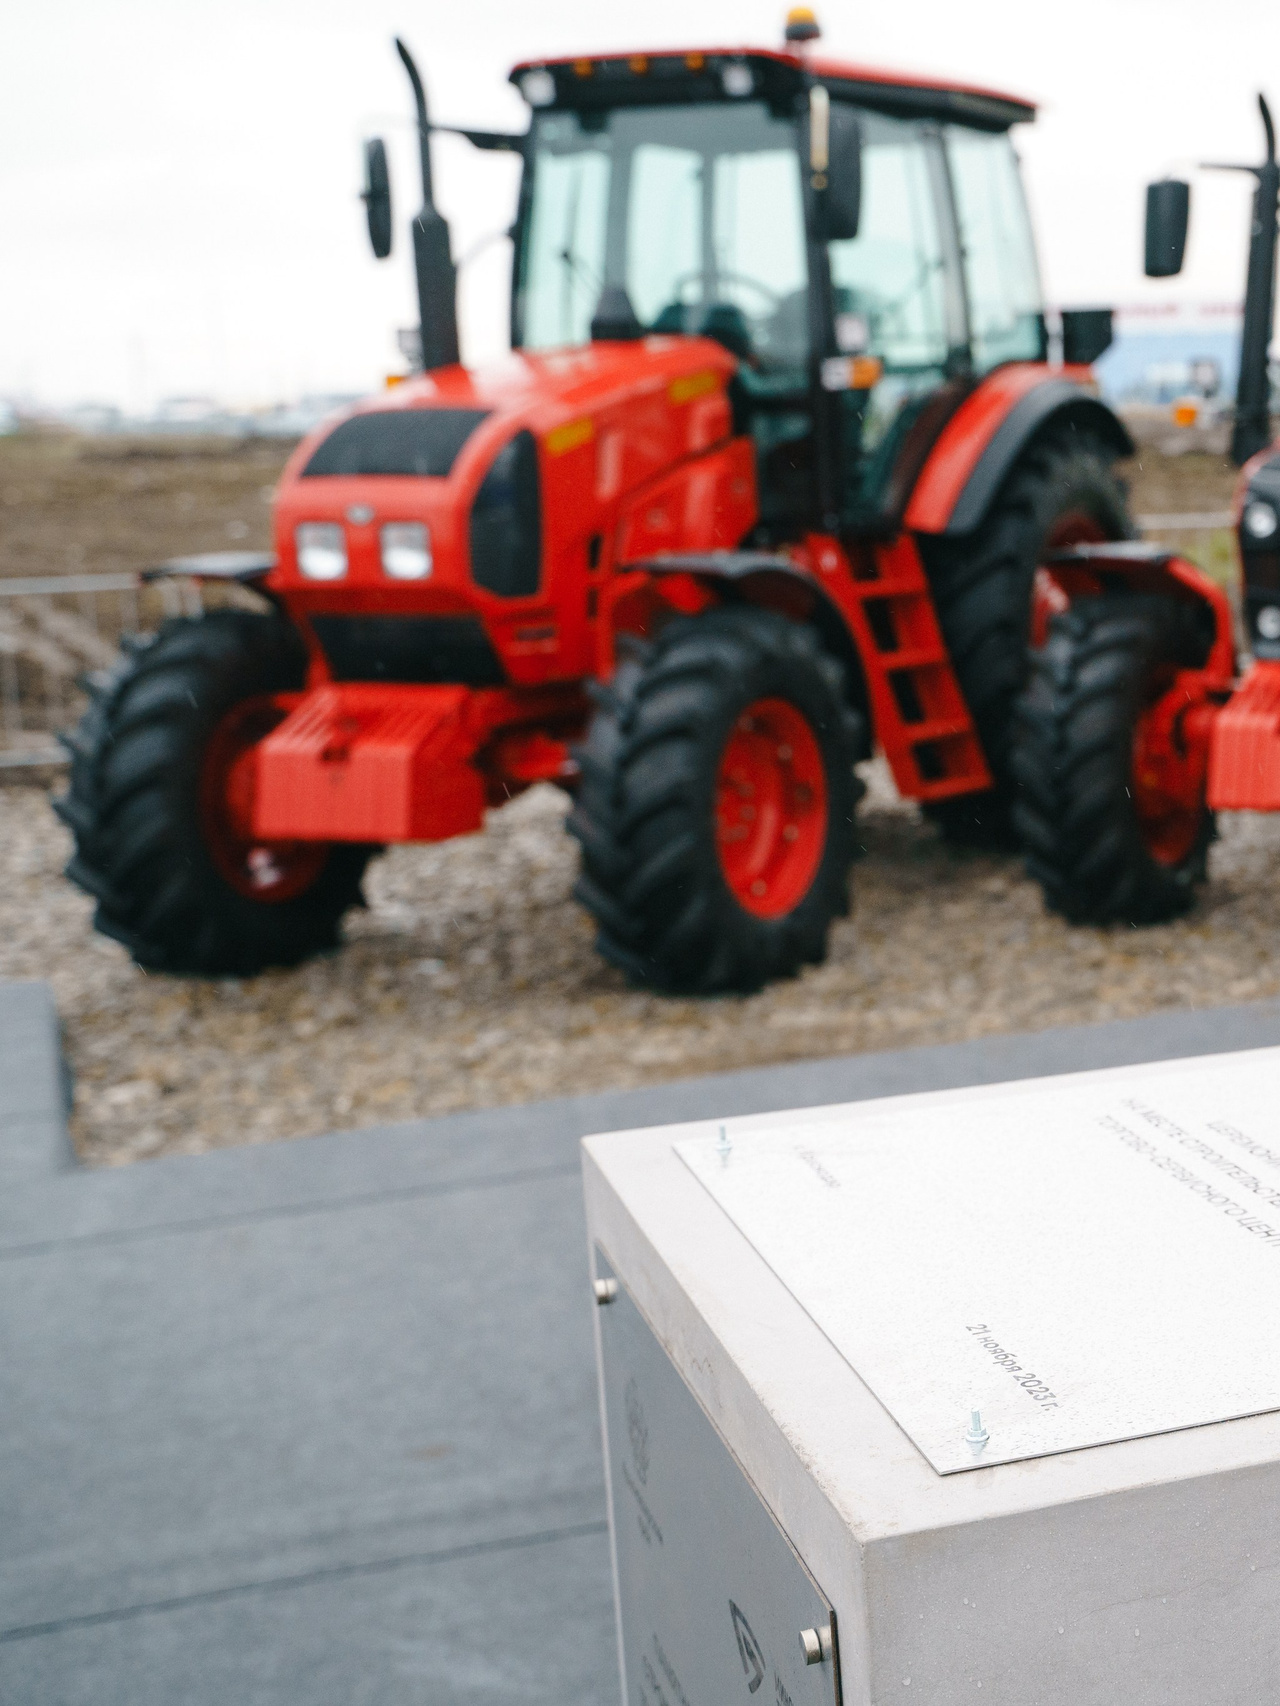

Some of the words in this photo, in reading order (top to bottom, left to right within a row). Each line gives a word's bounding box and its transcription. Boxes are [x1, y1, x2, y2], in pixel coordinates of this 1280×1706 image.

[965, 1323, 992, 1336] 21
[977, 1336, 1022, 1373] ноября
[1013, 1373, 1057, 1401] 2023
